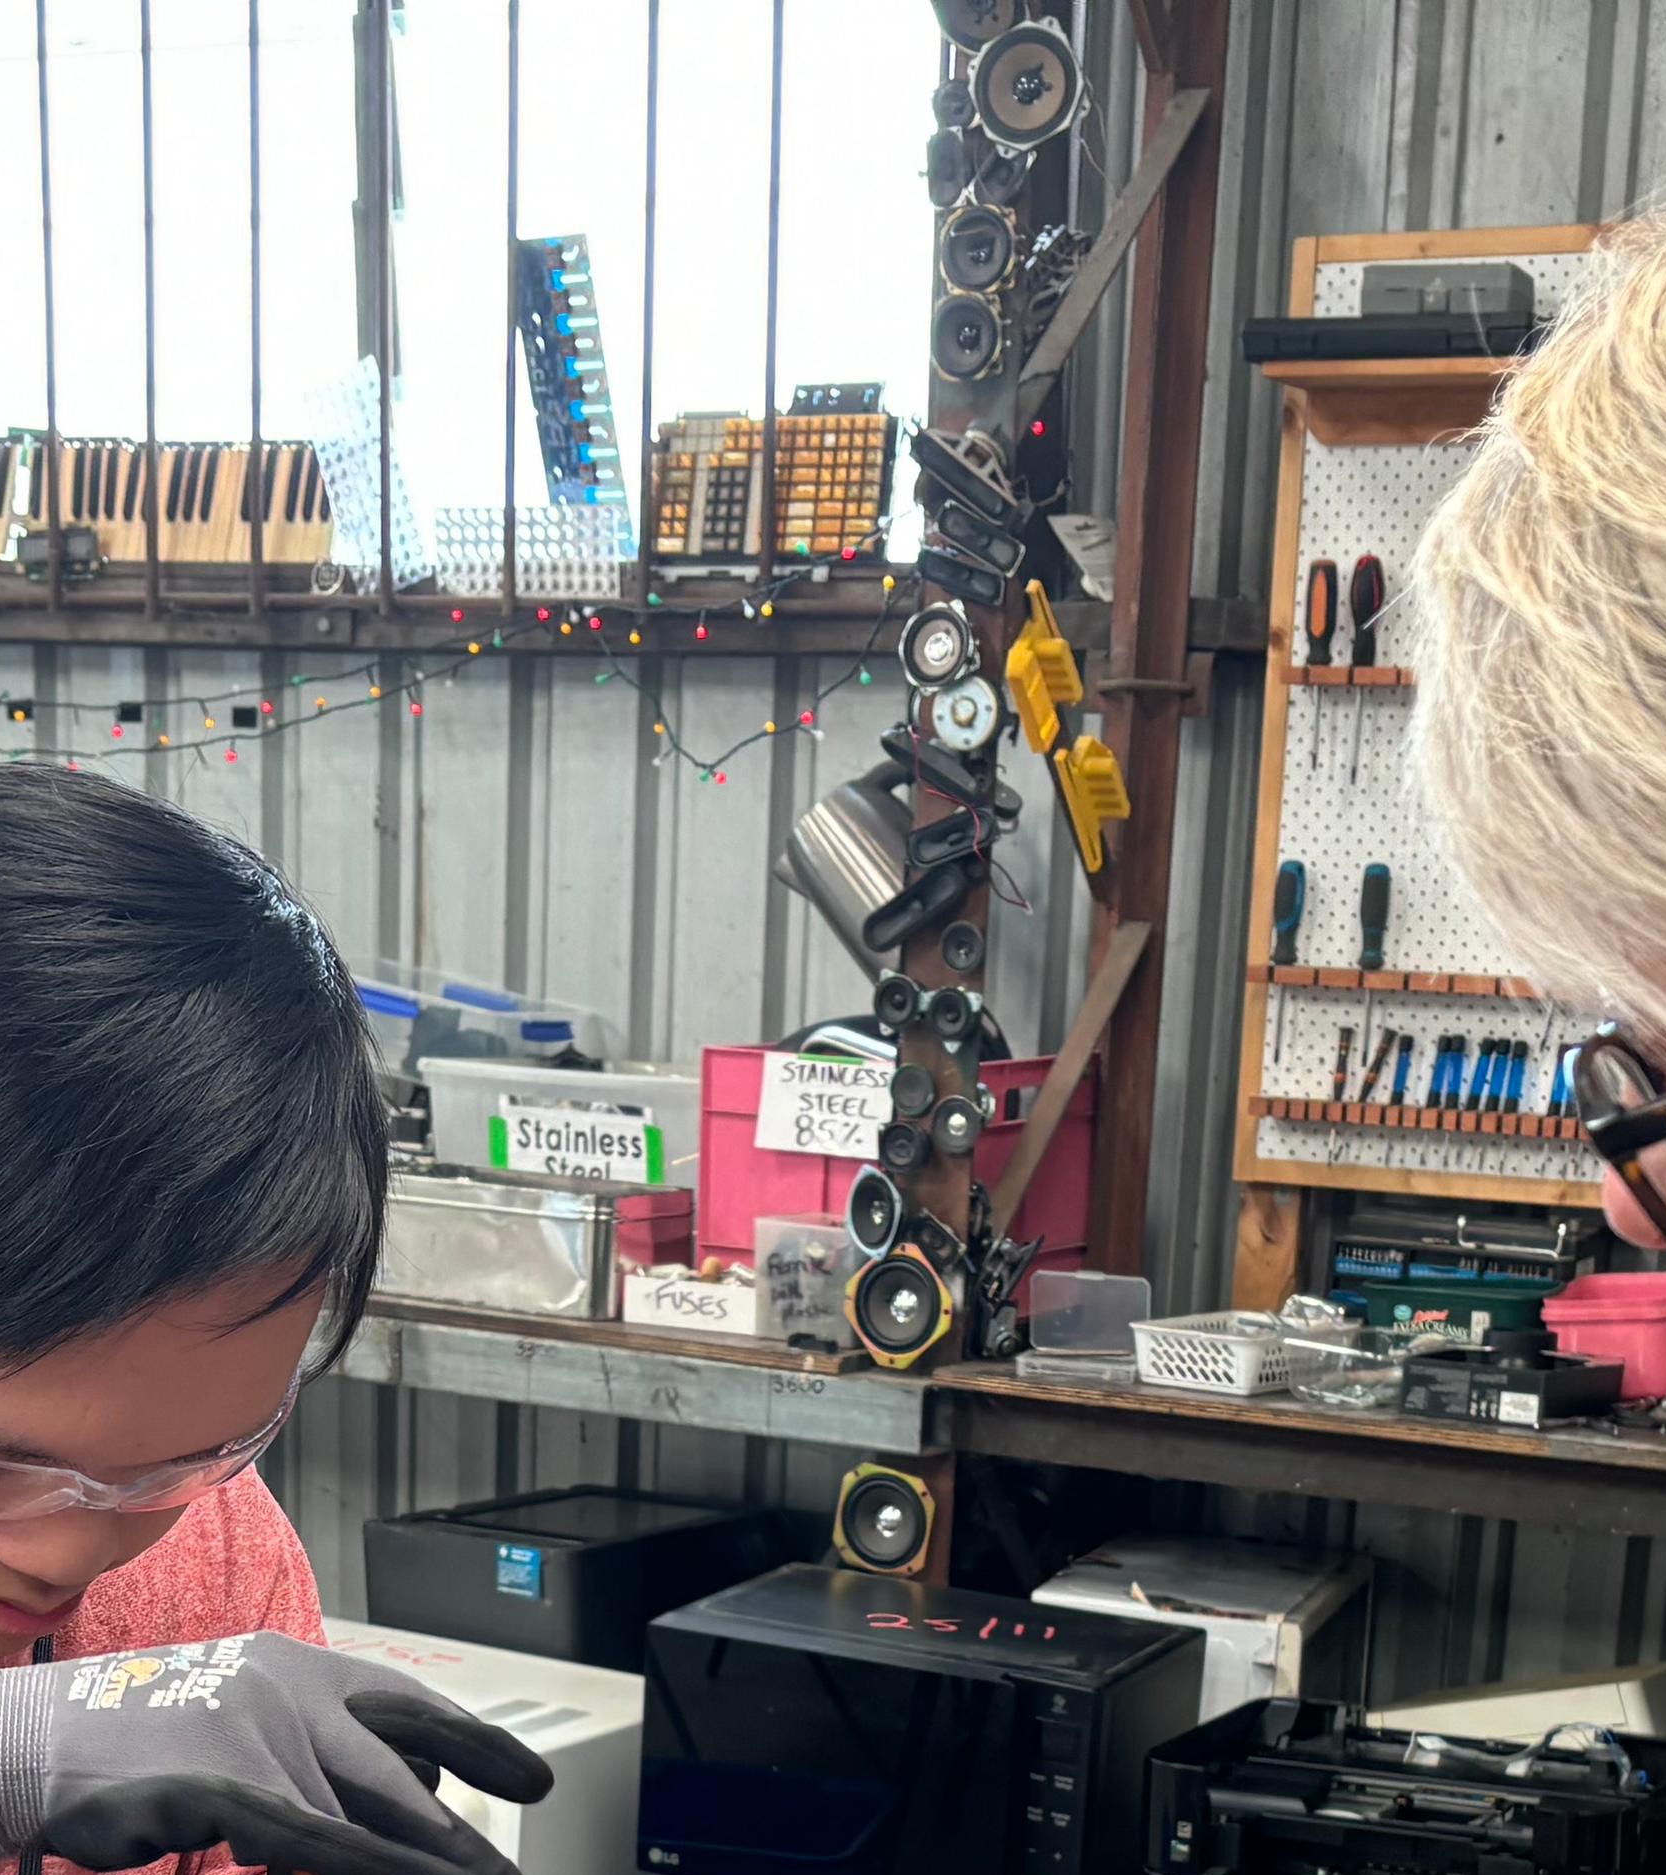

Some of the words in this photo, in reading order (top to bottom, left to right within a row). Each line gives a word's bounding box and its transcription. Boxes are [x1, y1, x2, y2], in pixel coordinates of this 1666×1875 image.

[799, 1092, 878, 1119] STEEL
[517, 1117, 643, 1159] Stainless
[655, 1281, 728, 1319] FUSES
